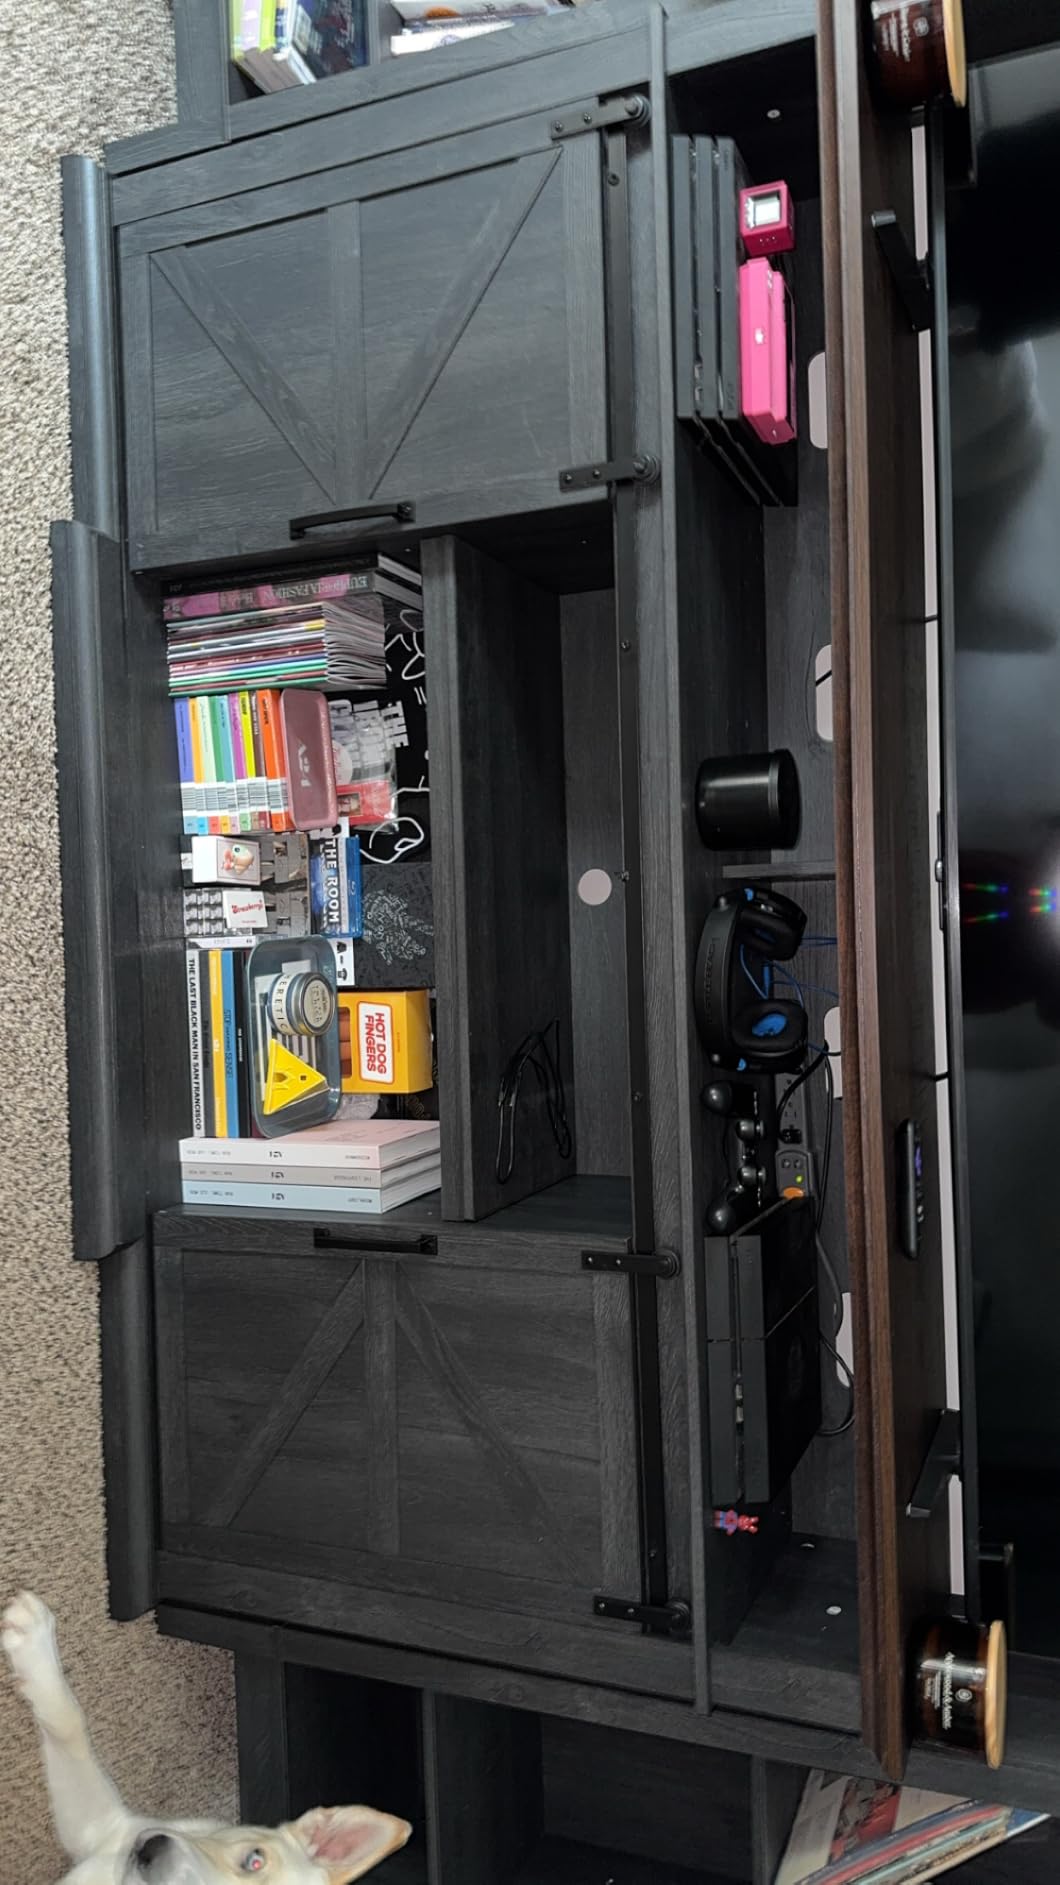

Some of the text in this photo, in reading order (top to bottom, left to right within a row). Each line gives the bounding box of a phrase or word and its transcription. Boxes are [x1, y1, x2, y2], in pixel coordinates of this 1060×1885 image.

[379, 700, 409, 749] THE
[297, 740, 311, 788] A24
[325, 839, 339, 923] THE ROOM
[188, 958, 196, 975] THE
[189, 977, 197, 998] LAST
[190, 1000, 198, 1028] BLACK
[191, 1030, 199, 1050] MAN
[192, 1051, 199, 1060] IN
[364, 1014, 377, 1072] FINGERS
[374, 1012, 387, 1074] HOT DOG
[194, 1081, 202, 1130] FRANCISCO
